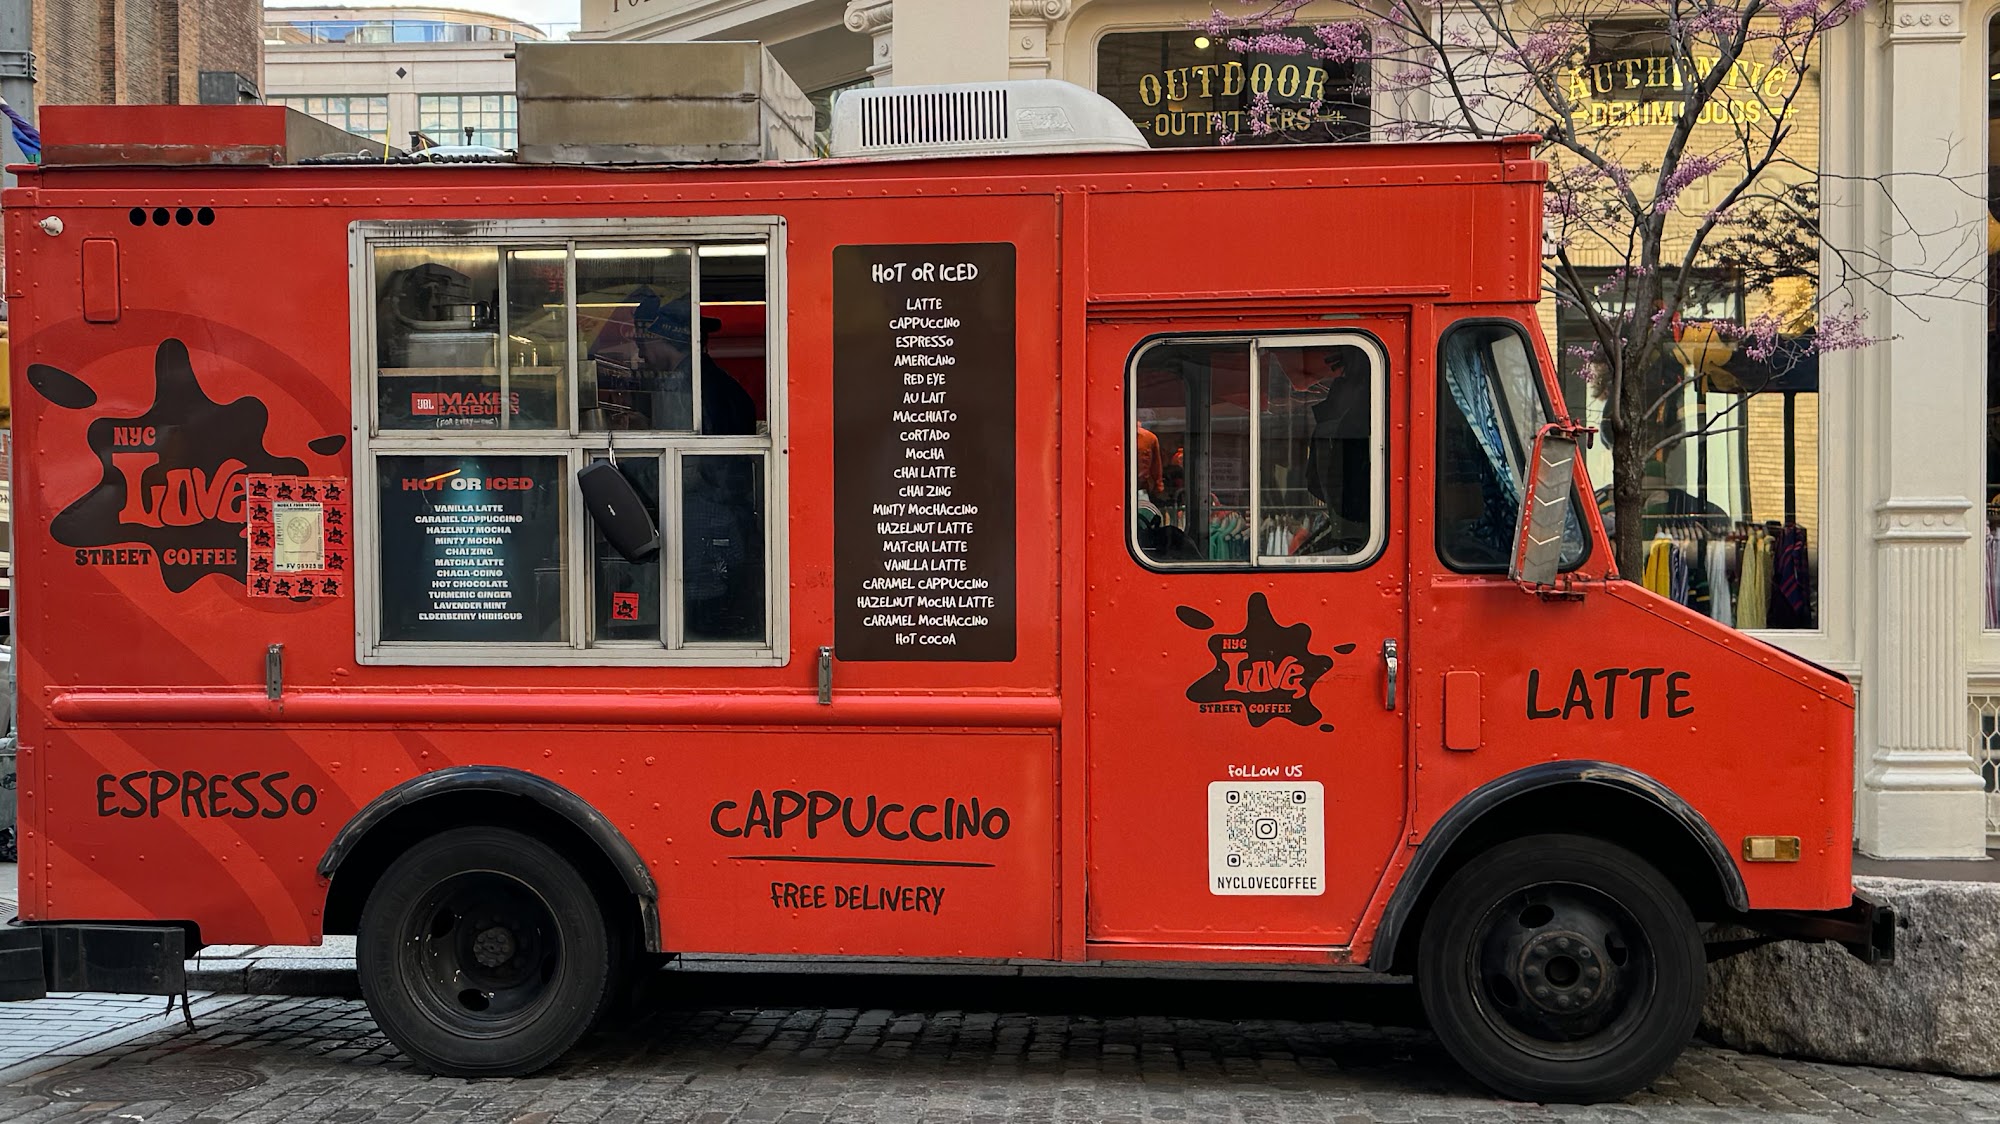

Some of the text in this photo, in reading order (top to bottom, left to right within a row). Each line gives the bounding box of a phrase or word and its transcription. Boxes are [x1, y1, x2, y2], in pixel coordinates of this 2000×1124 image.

[1139, 63, 1329, 107] OUTDOOR
[1591, 100, 1762, 126] DENIM OODS
[871, 262, 979, 284] HOT OR ICED
[906, 297, 943, 311] LATTE
[889, 316, 961, 330] CAPPUCCINO
[895, 335, 954, 348] ESPRESSO
[893, 353, 956, 367] AMERICANO
[903, 372, 946, 387] RED EYE
[902, 391, 947, 404] AU LAIT
[892, 409, 957, 424] MACCHIATO
[113, 426, 156, 446] NYC
[899, 428, 951, 442] CORTADO
[905, 447, 945, 461] MOCHA
[893, 465, 957, 479] CHAI LATTE
[402, 477, 534, 491] HOT OR ICED
[898, 484, 952, 498] CHAI ZING
[433, 504, 504, 513] VANILLA LATTE
[872, 503, 979, 517] MINTY MOCHACCINO
[414, 515, 524, 524] CARAMEL CAPPUCCINO
[426, 525, 512, 534] HAZELNUT MOCHA
[877, 521, 974, 535] HAZELNUT LATTE
[434, 536, 503, 545] MINTY MOCHA
[882, 540, 968, 553] MATCHA LATTE
[75, 548, 237, 566] STREET COFFEE
[445, 547, 494, 556] CHAI ZING
[434, 558, 505, 567] MATCHA LATTE
[883, 558, 967, 572] VANILLA LATTE
[431, 580, 509, 588] HOT CHOCOLATE
[862, 577, 989, 590] CARAMEL CAPPUCCINO
[428, 590, 512, 599] TURMERIC GINGER
[433, 601, 508, 610] LAVENDER MINT
[856, 595, 995, 609] HAZELNUT MOCHA LATTE
[418, 612, 523, 621] ELDERBERRY HIBISCUS
[863, 614, 989, 627] CARAMEL MOCHACCINO
[895, 632, 957, 646] HOT COCOA
[1222, 638, 1247, 650] NYC
[1526, 668, 1695, 720] LATTE
[1199, 703, 1292, 714] STREET COFFEE
[1228, 764, 1303, 777] FOLLOW US
[96, 770, 317, 819] ESPRESSO
[710, 789, 1010, 842] CAPPUCCINO
[1216, 876, 1318, 890] NYCLOVECOFFEE
[770, 882, 946, 916] FREE DELIVERY
